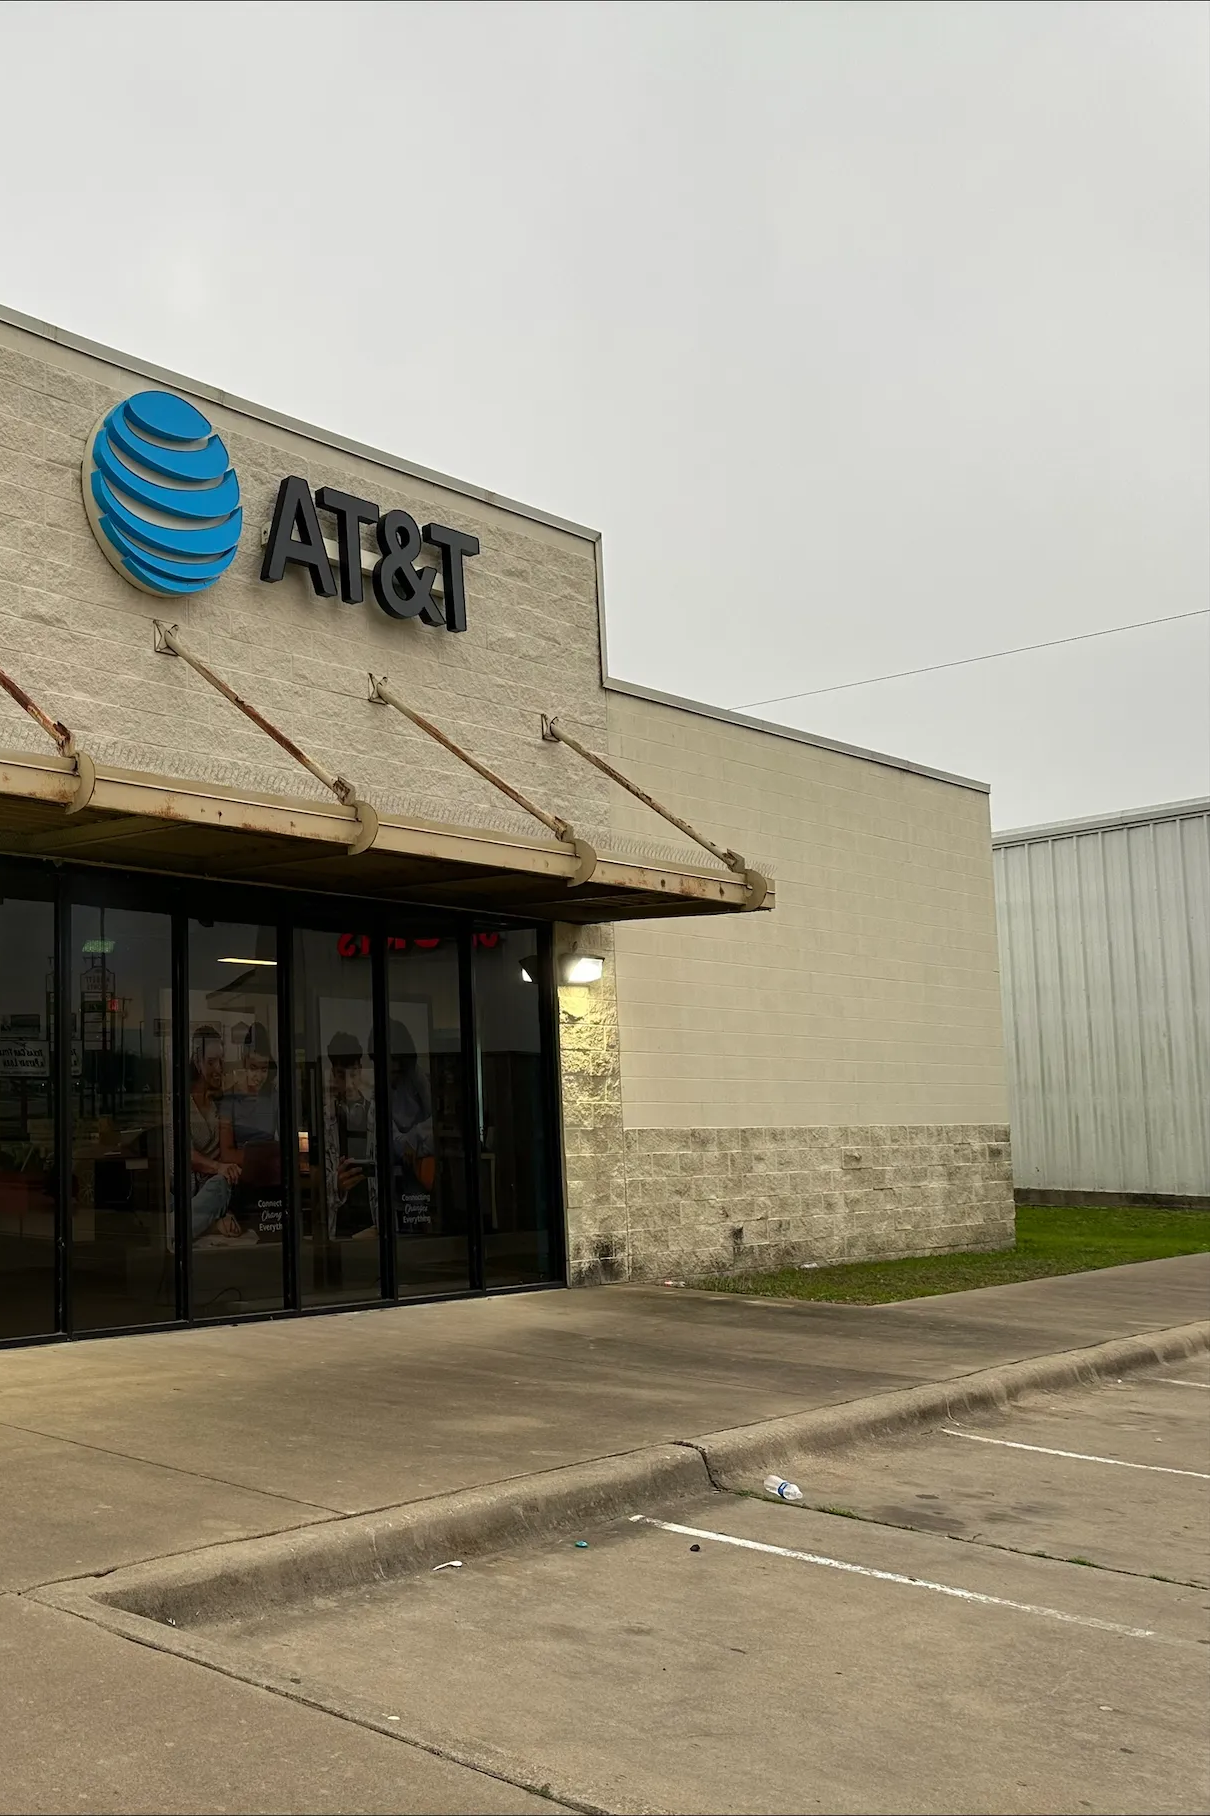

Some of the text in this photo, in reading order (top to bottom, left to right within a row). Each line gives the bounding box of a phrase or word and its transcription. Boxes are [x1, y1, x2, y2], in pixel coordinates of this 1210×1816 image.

[260, 475, 480, 633] AT&T
[257, 1199, 282, 1208] Connect
[261, 1208, 282, 1222] Chang
[402, 1215, 431, 1225] Everything
[259, 1223, 283, 1233] Everyth
